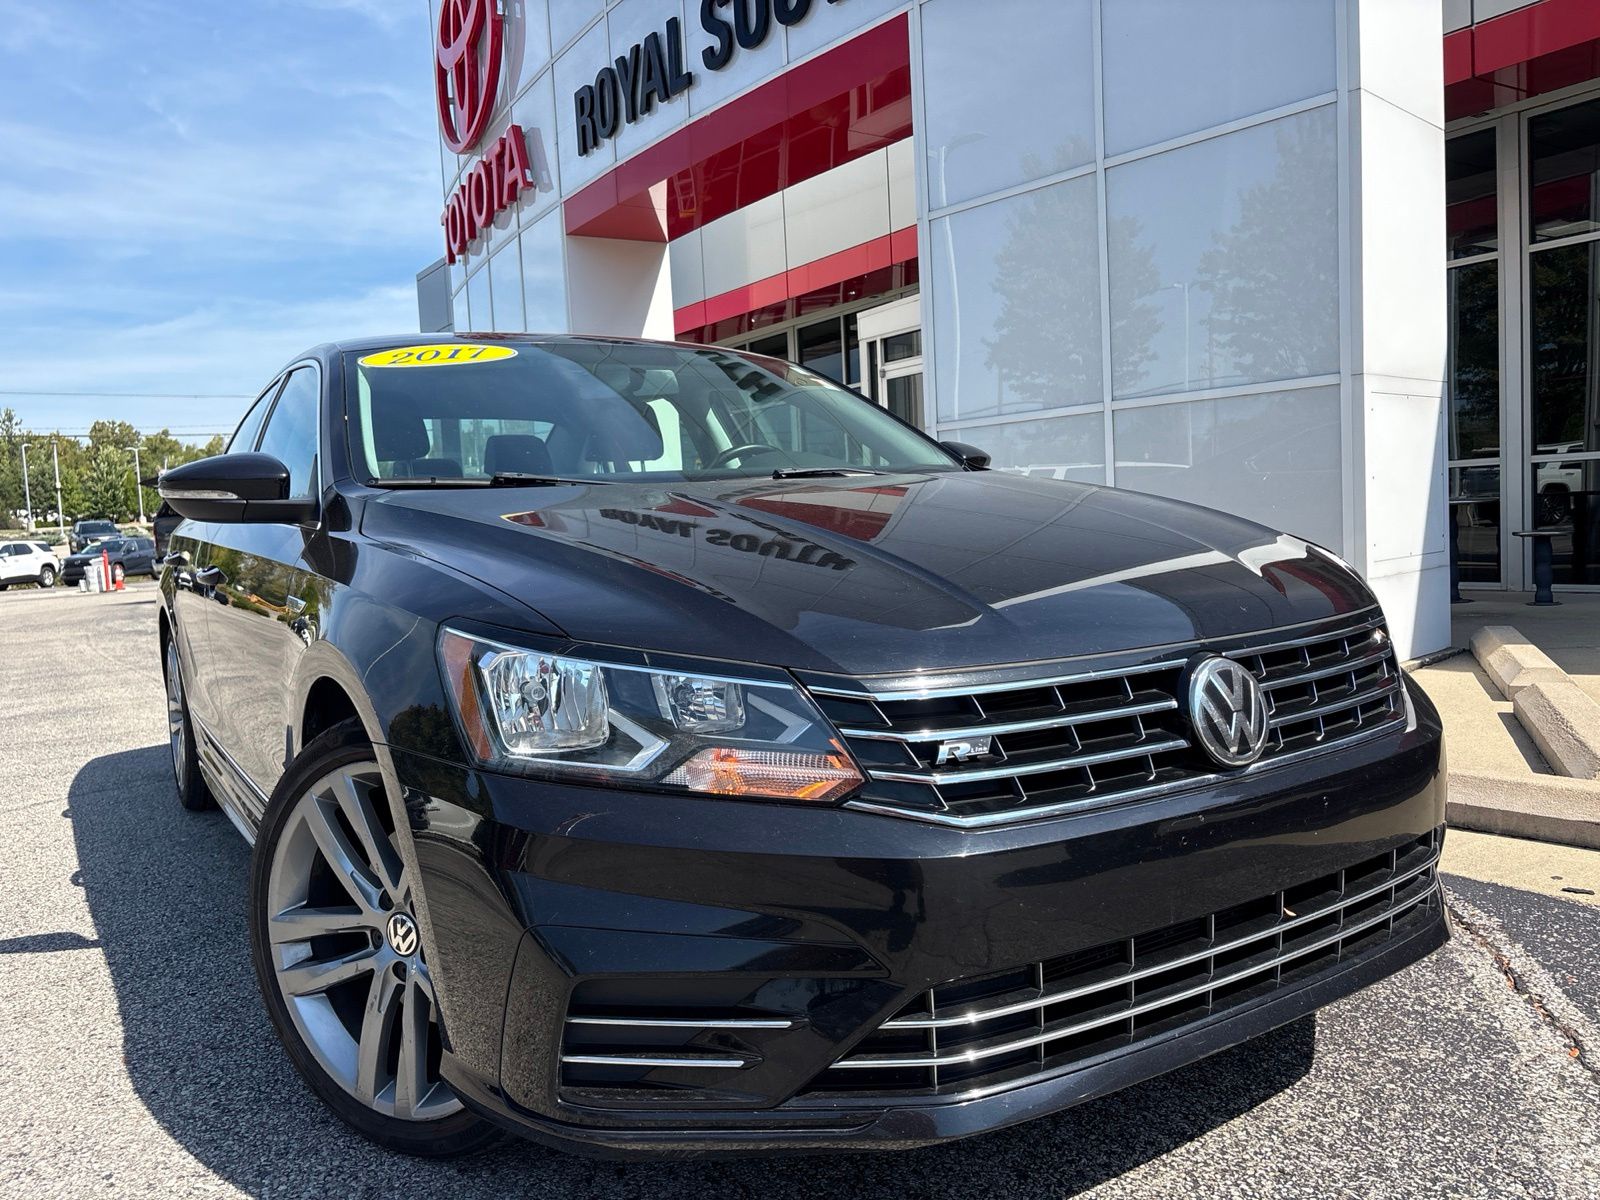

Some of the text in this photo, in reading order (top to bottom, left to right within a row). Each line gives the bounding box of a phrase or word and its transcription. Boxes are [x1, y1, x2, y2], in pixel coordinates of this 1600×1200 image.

[574, 16, 693, 157] ROYAL
[441, 124, 536, 266] TOYOTA
[388, 347, 487, 365] 2017
